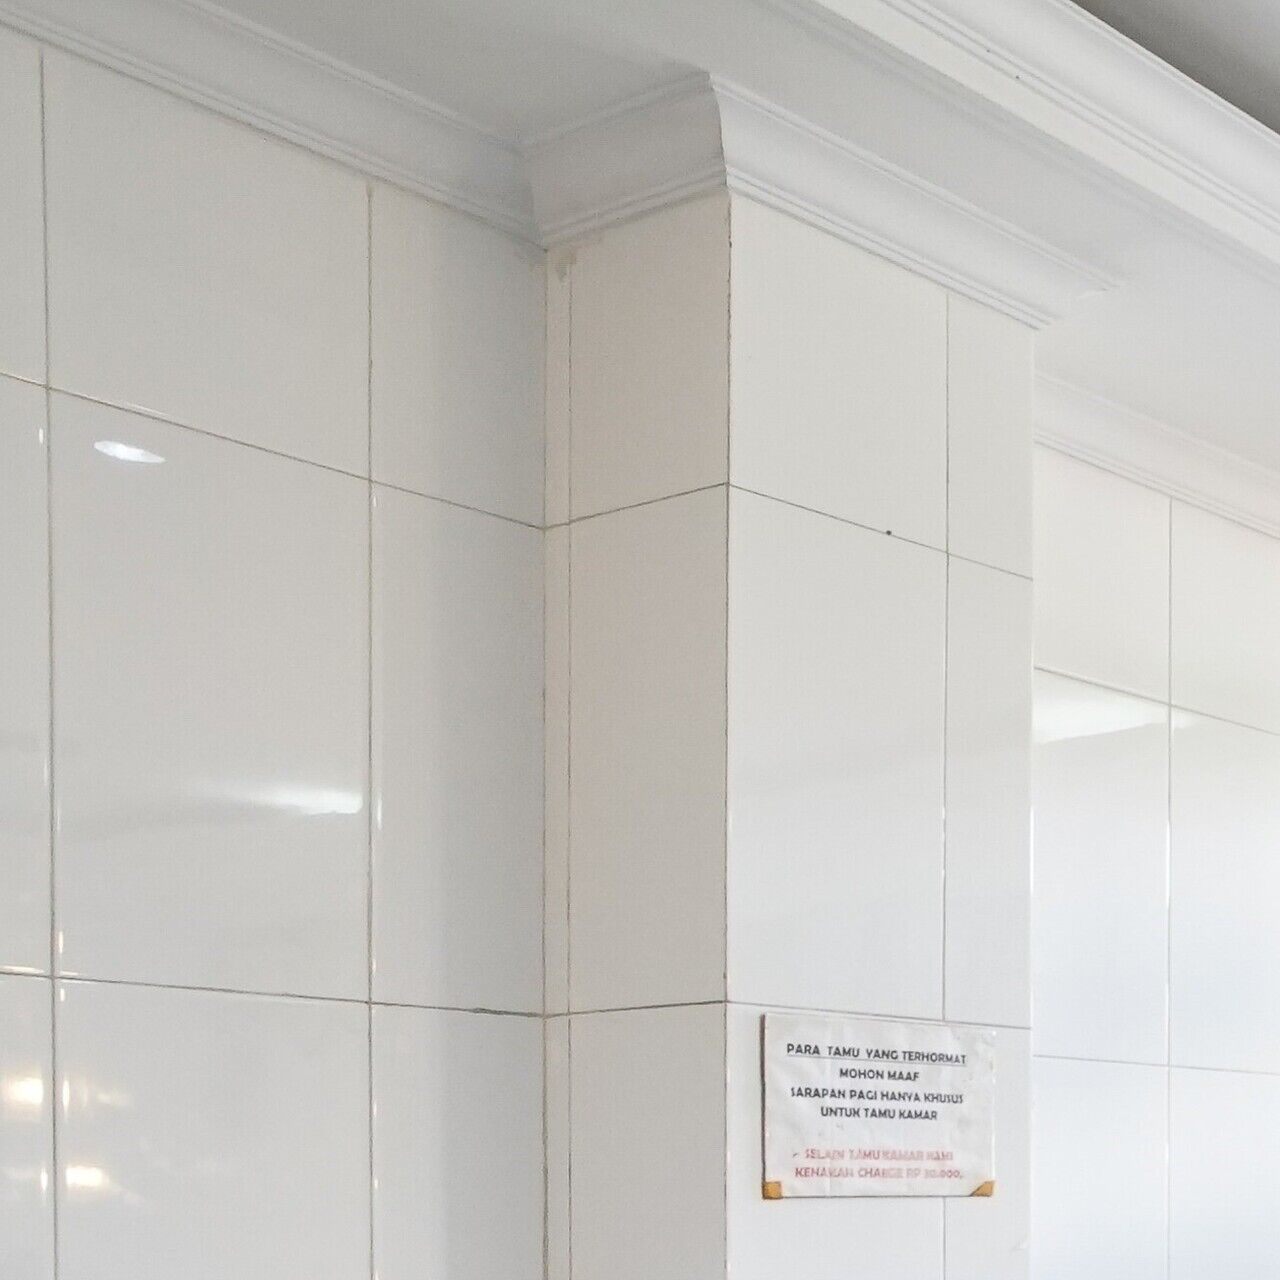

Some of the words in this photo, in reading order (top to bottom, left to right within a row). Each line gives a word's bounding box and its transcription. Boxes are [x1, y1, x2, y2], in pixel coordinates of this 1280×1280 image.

[787, 1043, 820, 1055] PARA
[828, 1045, 860, 1058] TAMU
[866, 1048, 899, 1060] YANG
[901, 1050, 967, 1064] TERHORMAT
[840, 1068, 884, 1080] MOHON
[887, 1070, 919, 1081] MAAF
[791, 1086, 846, 1099] SARAPAN
[849, 1089, 877, 1101] PAGI
[880, 1091, 921, 1103] HANYA
[924, 1093, 964, 1104] KHUSUS
[820, 1106, 860, 1117] UNTUK
[864, 1107, 896, 1119] TAMU
[899, 1109, 938, 1121] KAMAR
